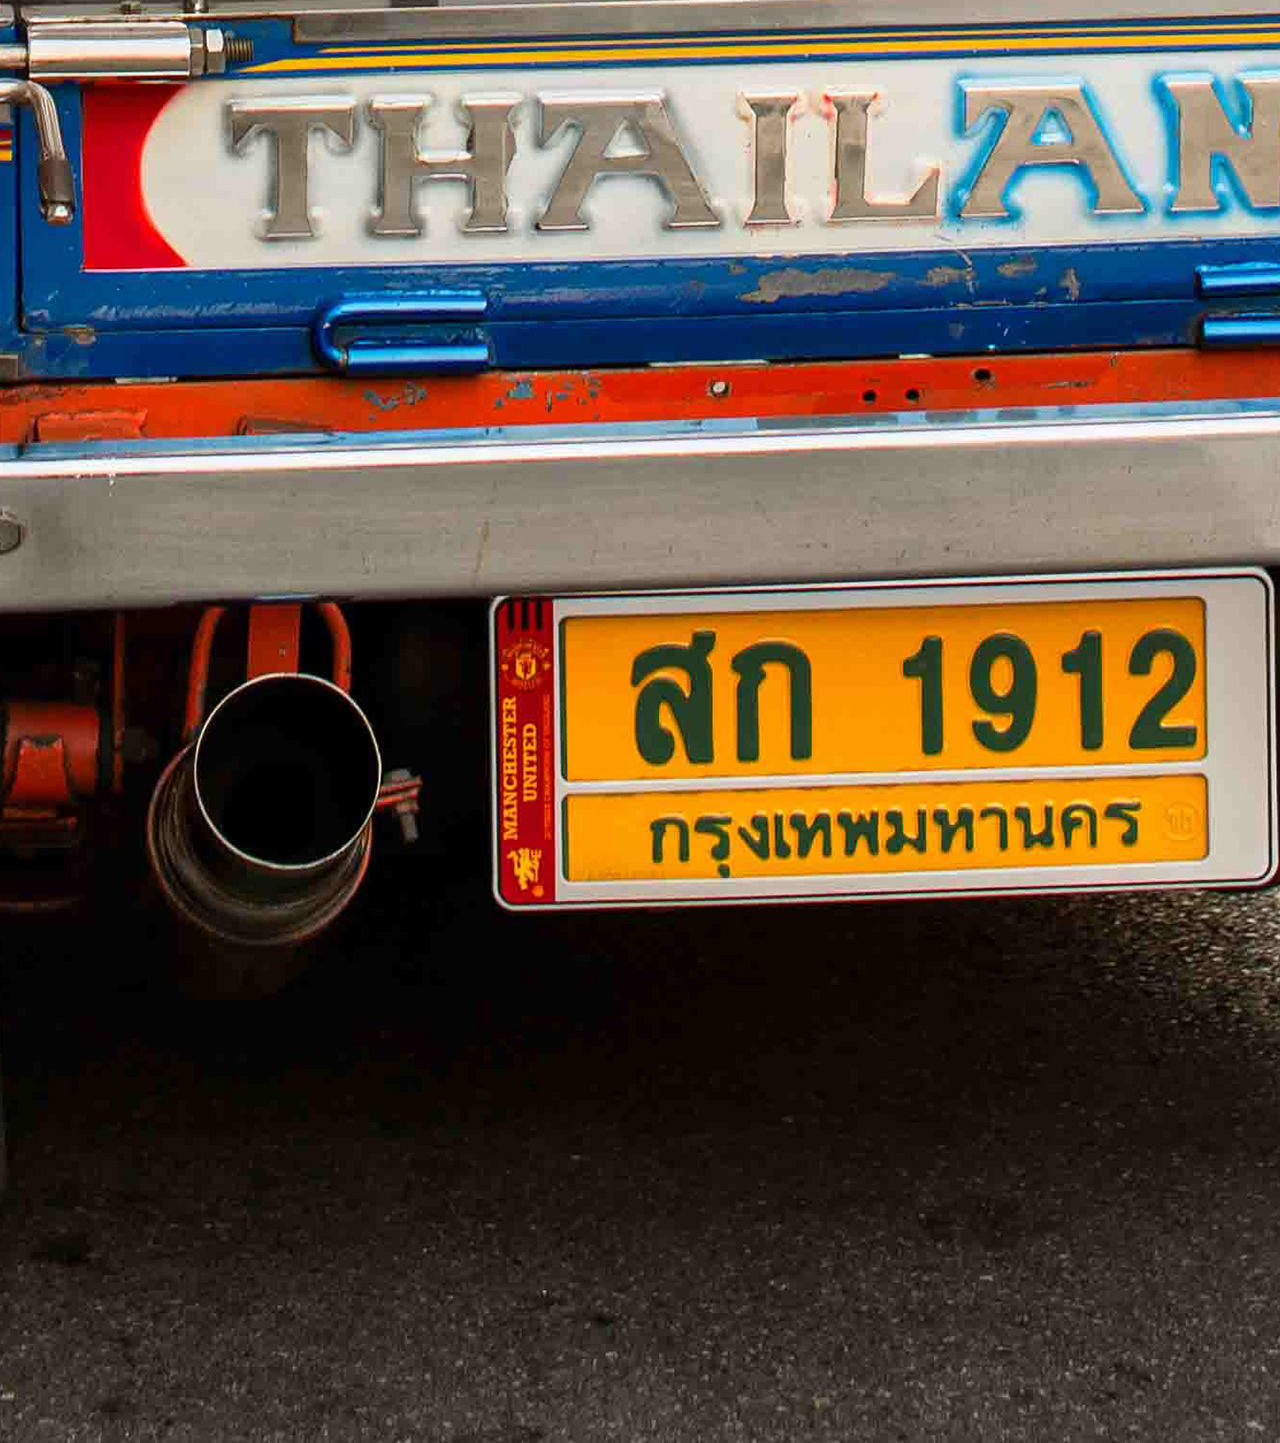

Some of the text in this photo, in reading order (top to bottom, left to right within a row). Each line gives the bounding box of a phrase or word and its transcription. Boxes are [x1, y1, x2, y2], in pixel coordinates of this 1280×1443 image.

[630, 631, 813, 765] สก
[902, 628, 1197, 756] 1912
[502, 696, 518, 841] MANCHESTER
[522, 722, 538, 802] UNITED
[649, 801, 1142, 878] กรุงเทพมหานคร
